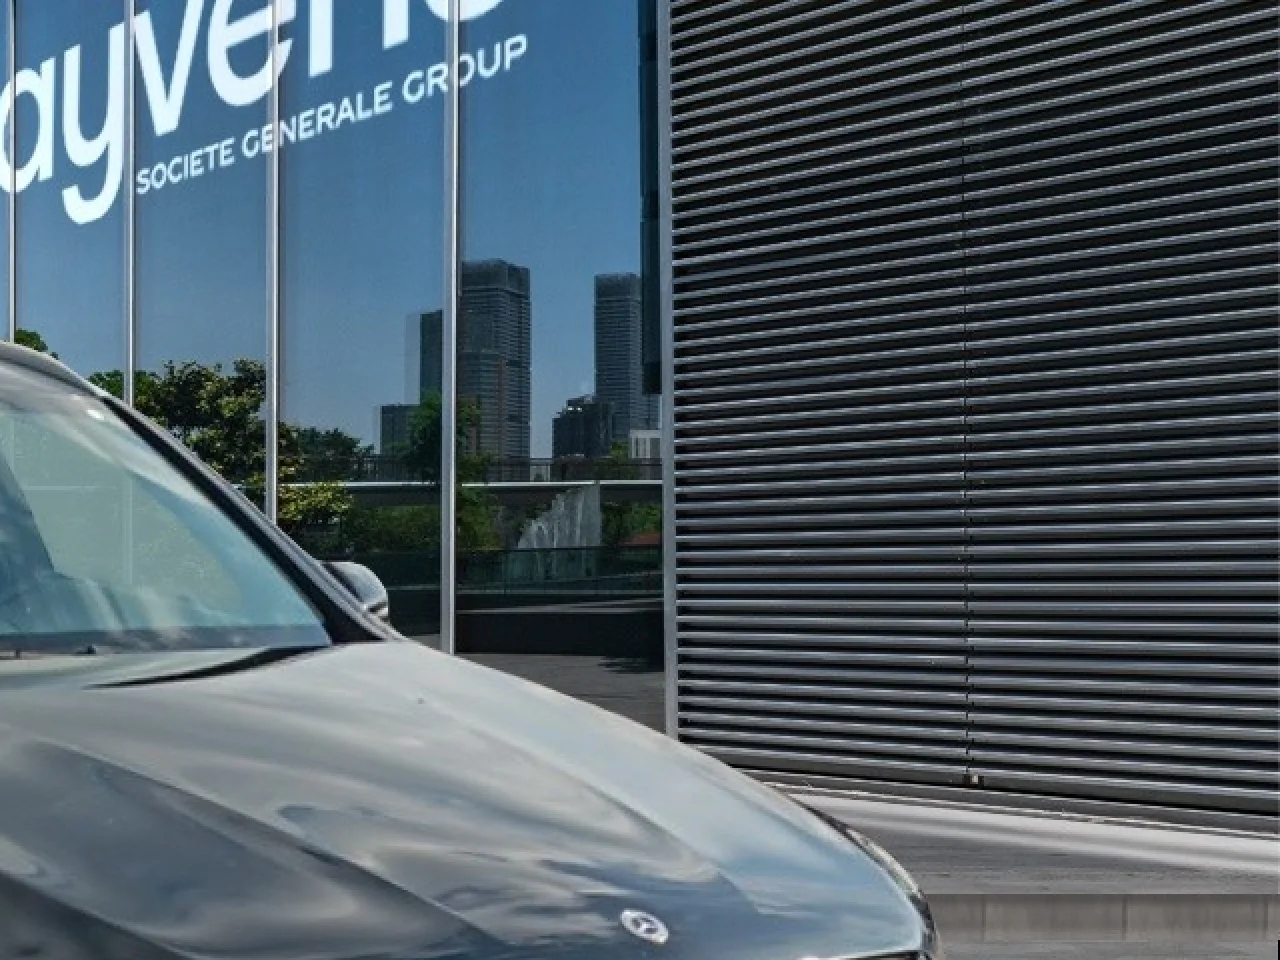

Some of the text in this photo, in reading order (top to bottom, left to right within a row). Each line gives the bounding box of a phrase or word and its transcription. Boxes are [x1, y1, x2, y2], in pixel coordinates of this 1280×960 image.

[136, 33, 528, 195] SOCIETE GENERALE GROUP
